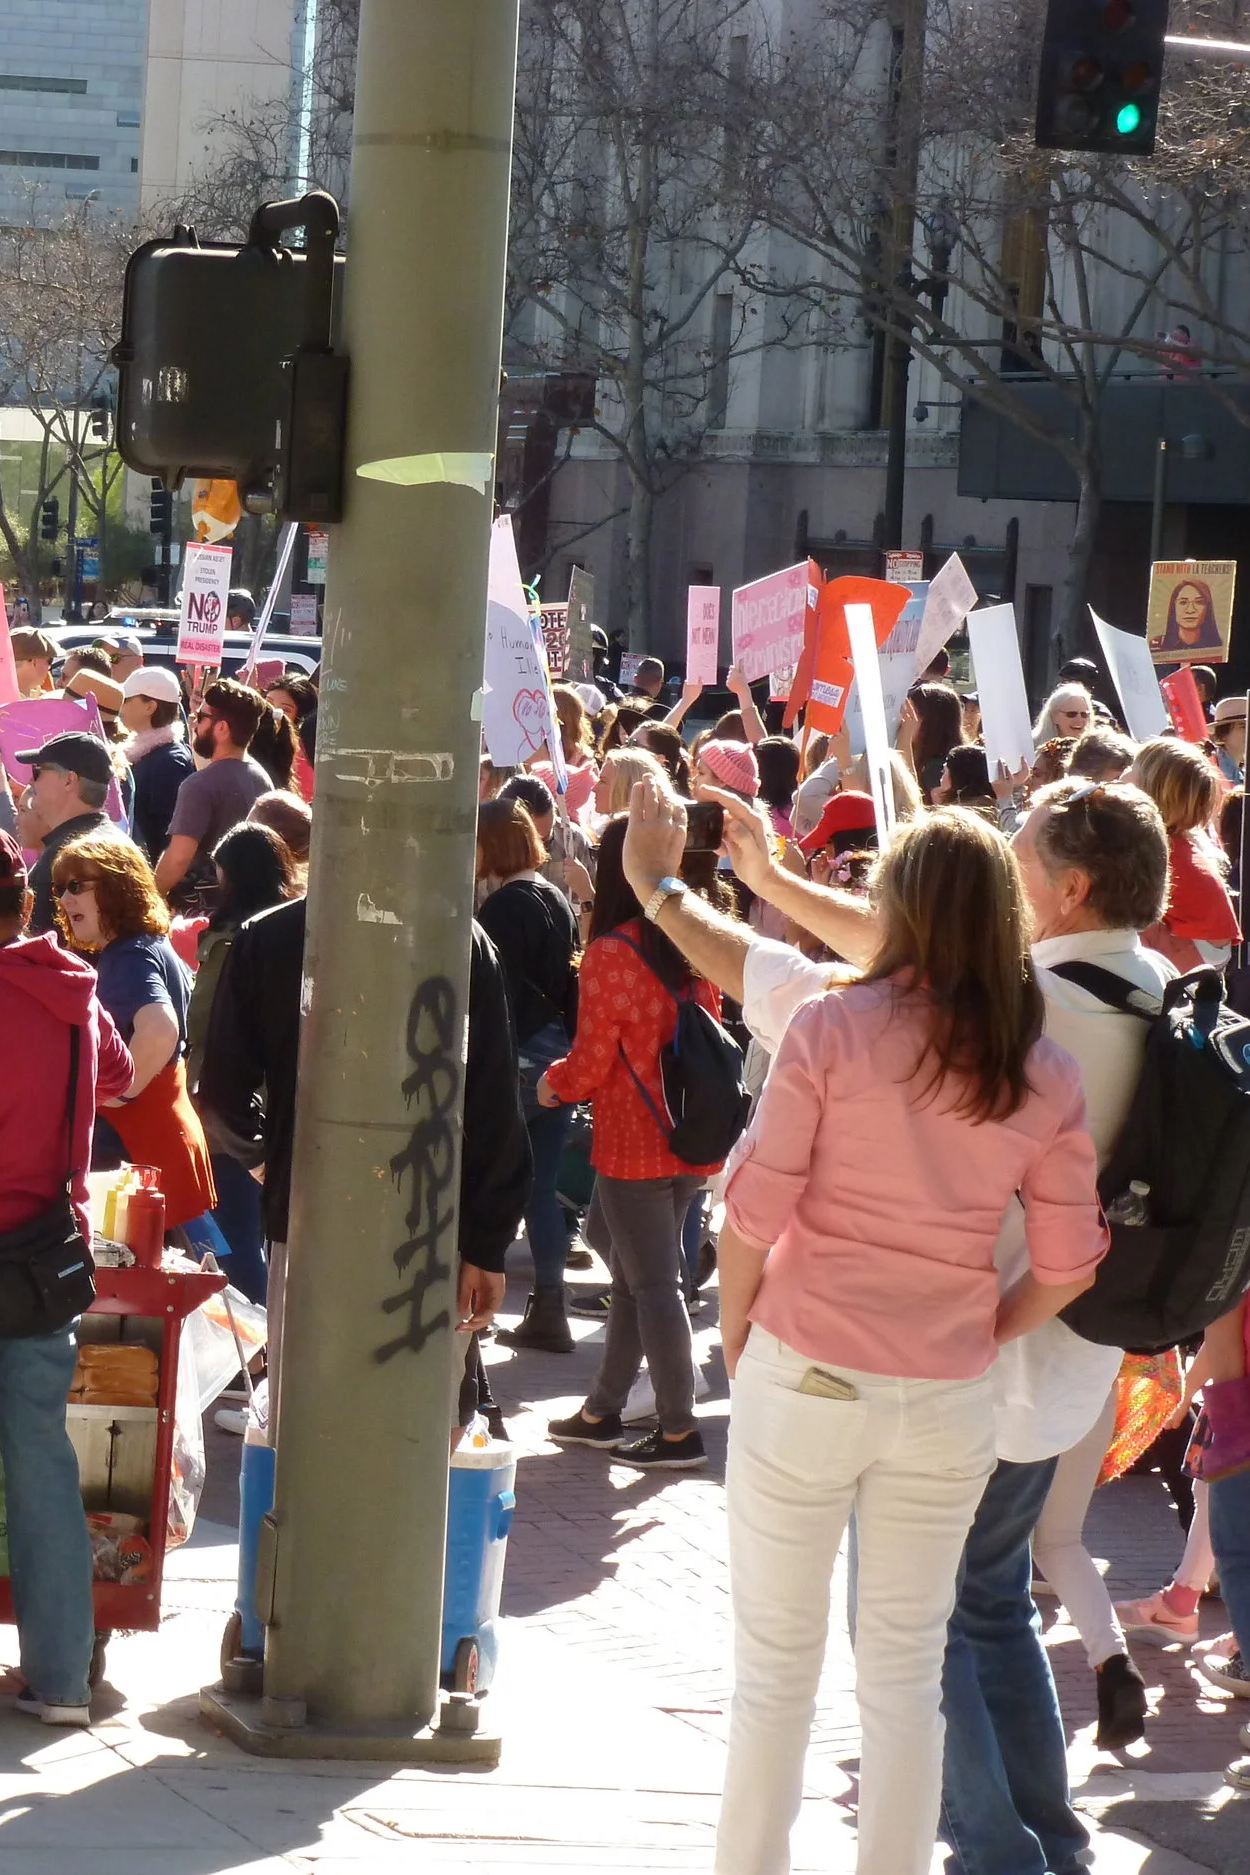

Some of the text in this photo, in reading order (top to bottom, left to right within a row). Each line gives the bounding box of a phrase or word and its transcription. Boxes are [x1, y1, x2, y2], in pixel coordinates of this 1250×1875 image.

[887, 559, 898, 569] NO
[187, 590, 221, 622] NO
[187, 620, 218, 635] TRUMP
[539, 612, 566, 628] OTE
[180, 640, 221, 653] REAL DISASTER
